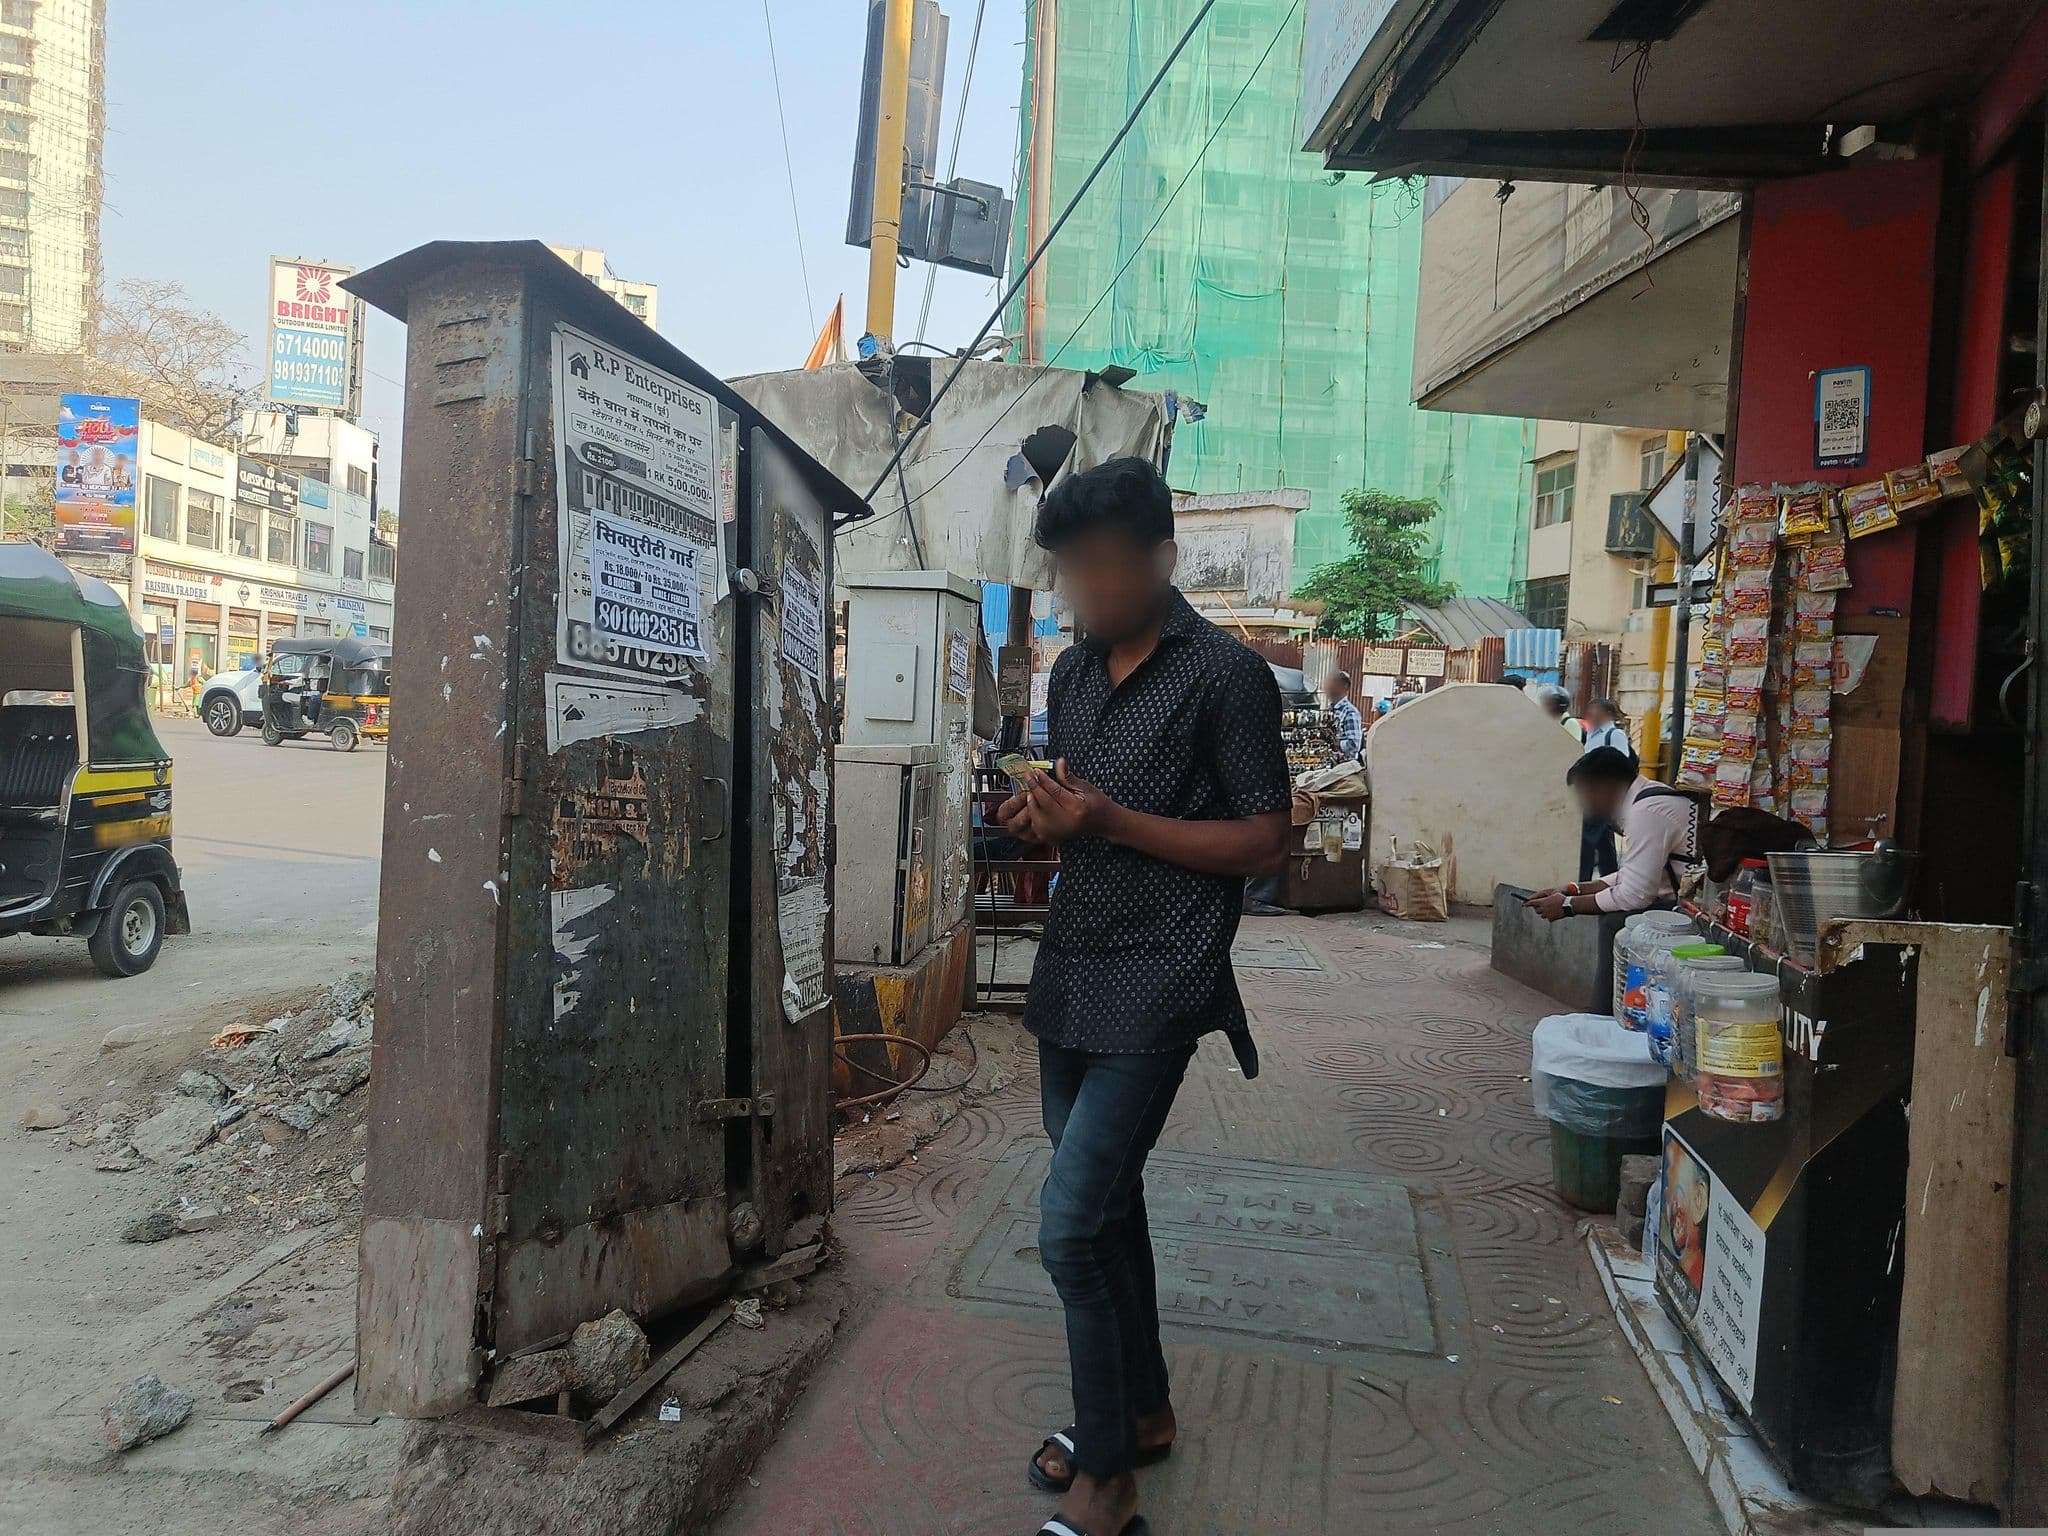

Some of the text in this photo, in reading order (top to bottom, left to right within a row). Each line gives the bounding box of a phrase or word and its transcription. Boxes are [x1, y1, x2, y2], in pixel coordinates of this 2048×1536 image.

[278, 300, 348, 324] BRIGHT
[278, 317, 348, 333] OUTDOOR MEDIA LIMITED
[593, 350, 702, 415] R.P Enterprises
[591, 408, 613, 423] स्टेशन
[615, 416, 622, 426] से
[624, 421, 637, 433] मात्र
[603, 399, 627, 416] चाल
[630, 406, 640, 422] में
[642, 415, 671, 435] सपनों
[673, 428, 686, 441] का
[689, 435, 702, 449] घर
[590, 425, 622, 443] 1,00,000/-
[654, 470, 665, 483] RK
[668, 476, 712, 500] 5,00,000/-
[669, 549, 695, 568] गार्ड
[145, 580, 207, 598] KRISHNA TRADERS
[260, 586, 308, 603] KRISHNA TRAVELS
[336, 598, 365, 612] KRISHNA
[599, 601, 696, 648] 8010028515
